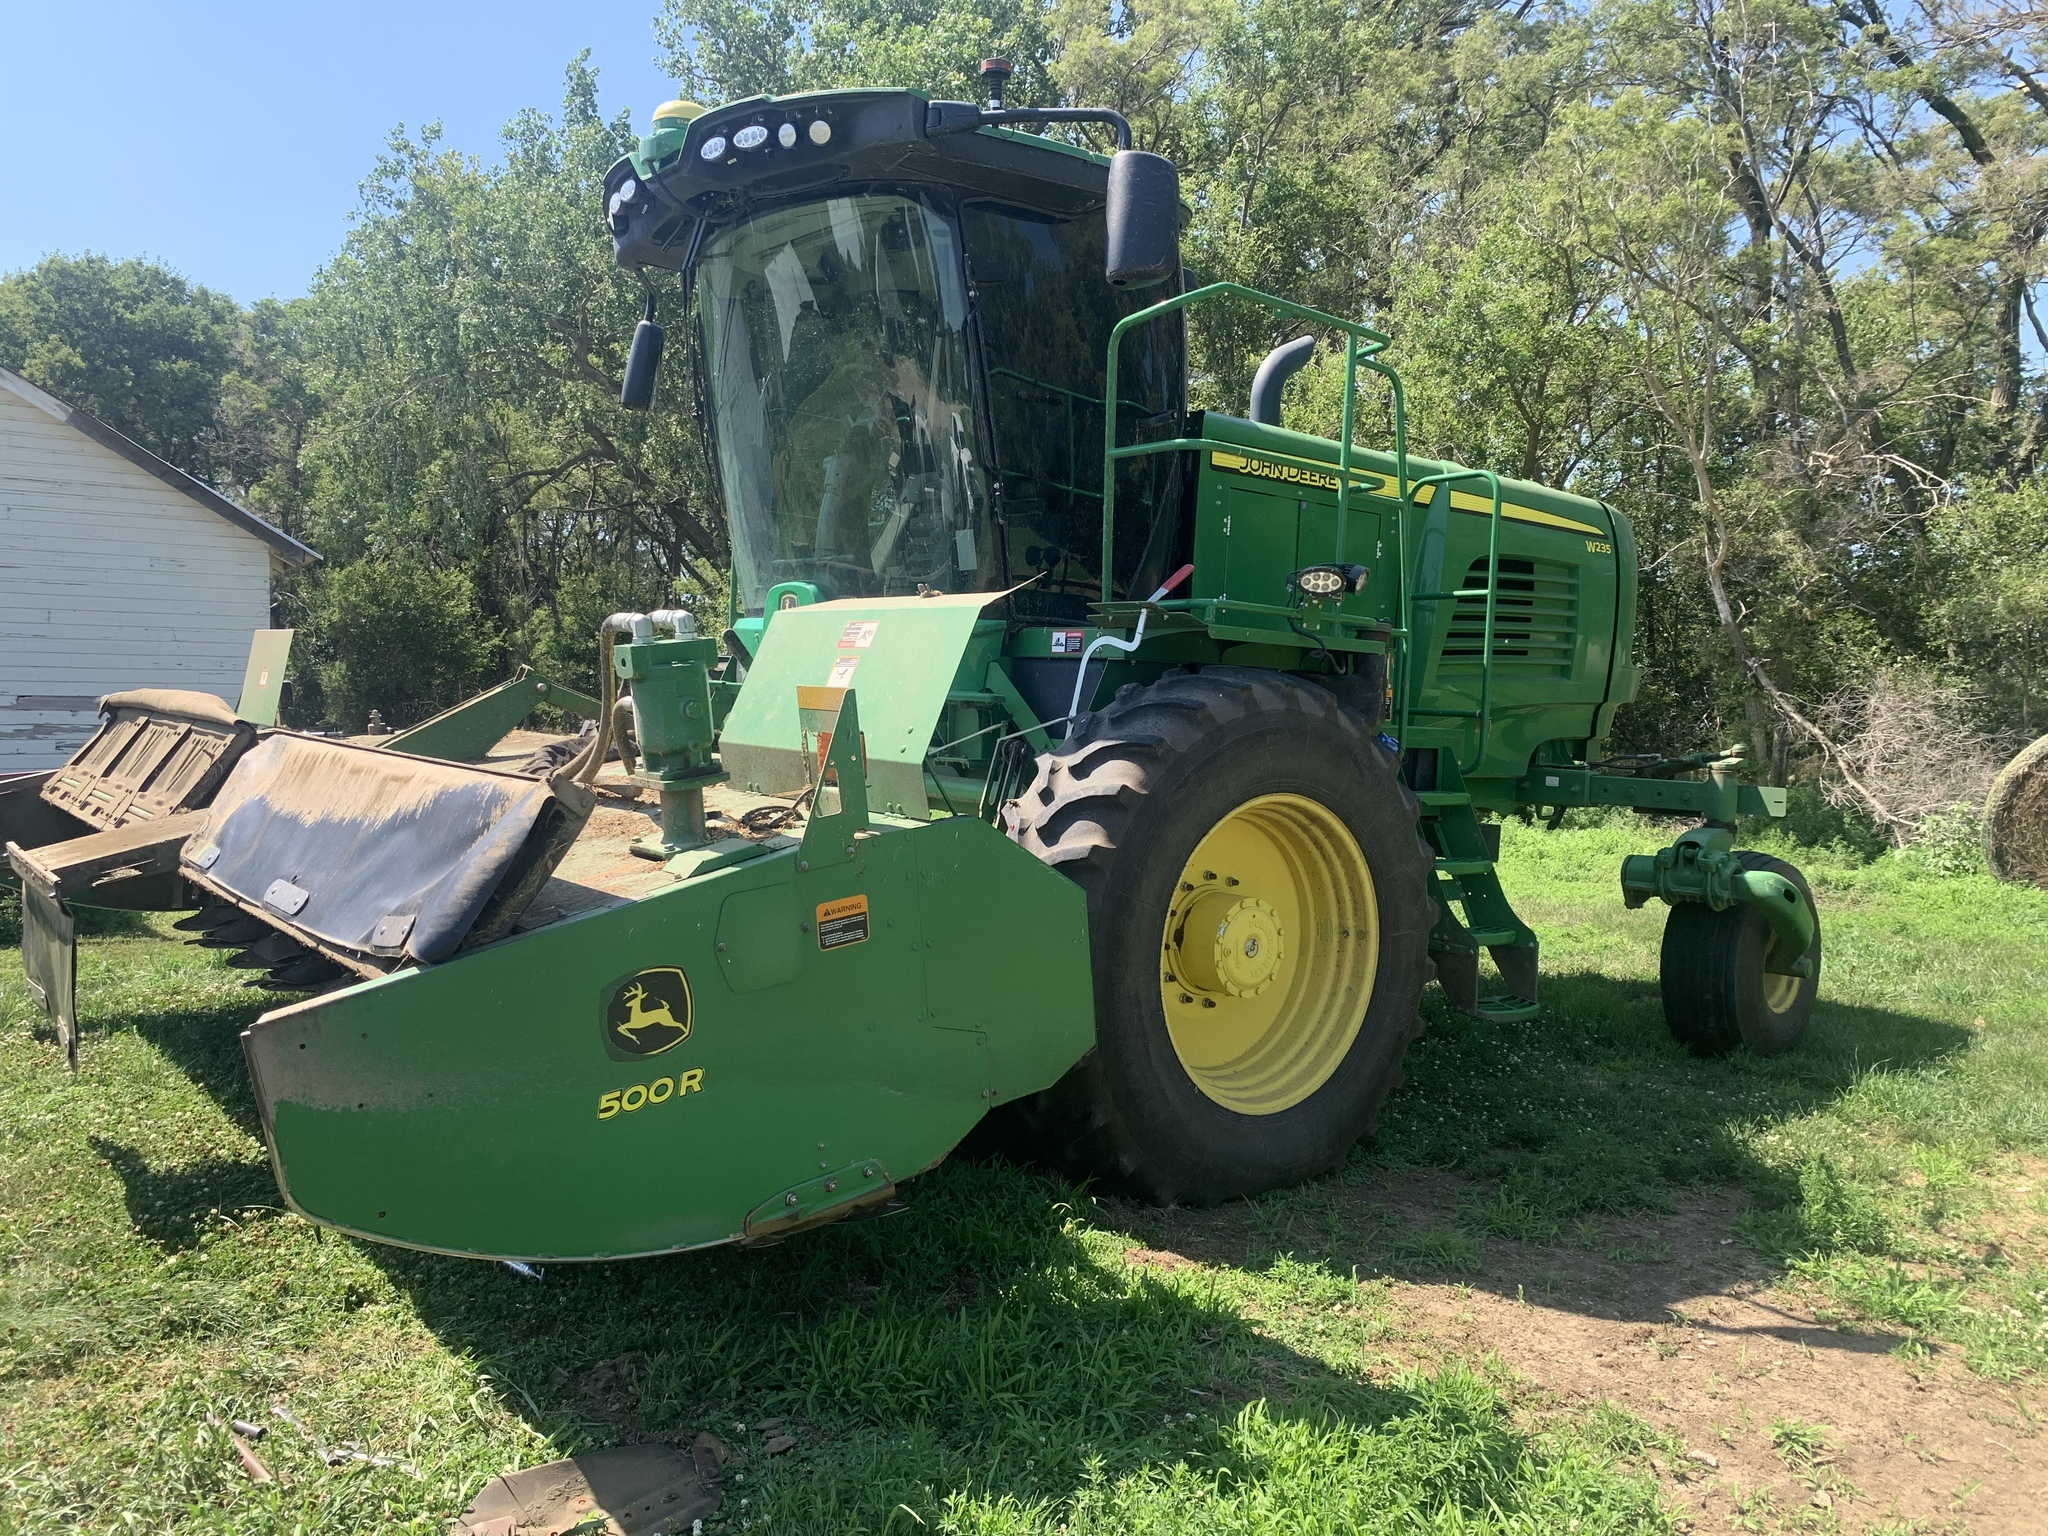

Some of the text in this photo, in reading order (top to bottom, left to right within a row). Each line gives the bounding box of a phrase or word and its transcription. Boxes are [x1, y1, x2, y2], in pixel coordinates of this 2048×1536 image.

[1239, 458, 1338, 489] JOHN DEERE
[1584, 539, 1612, 555] W235
[830, 902, 862, 915] WARNING
[597, 1066, 706, 1120] 500 R
